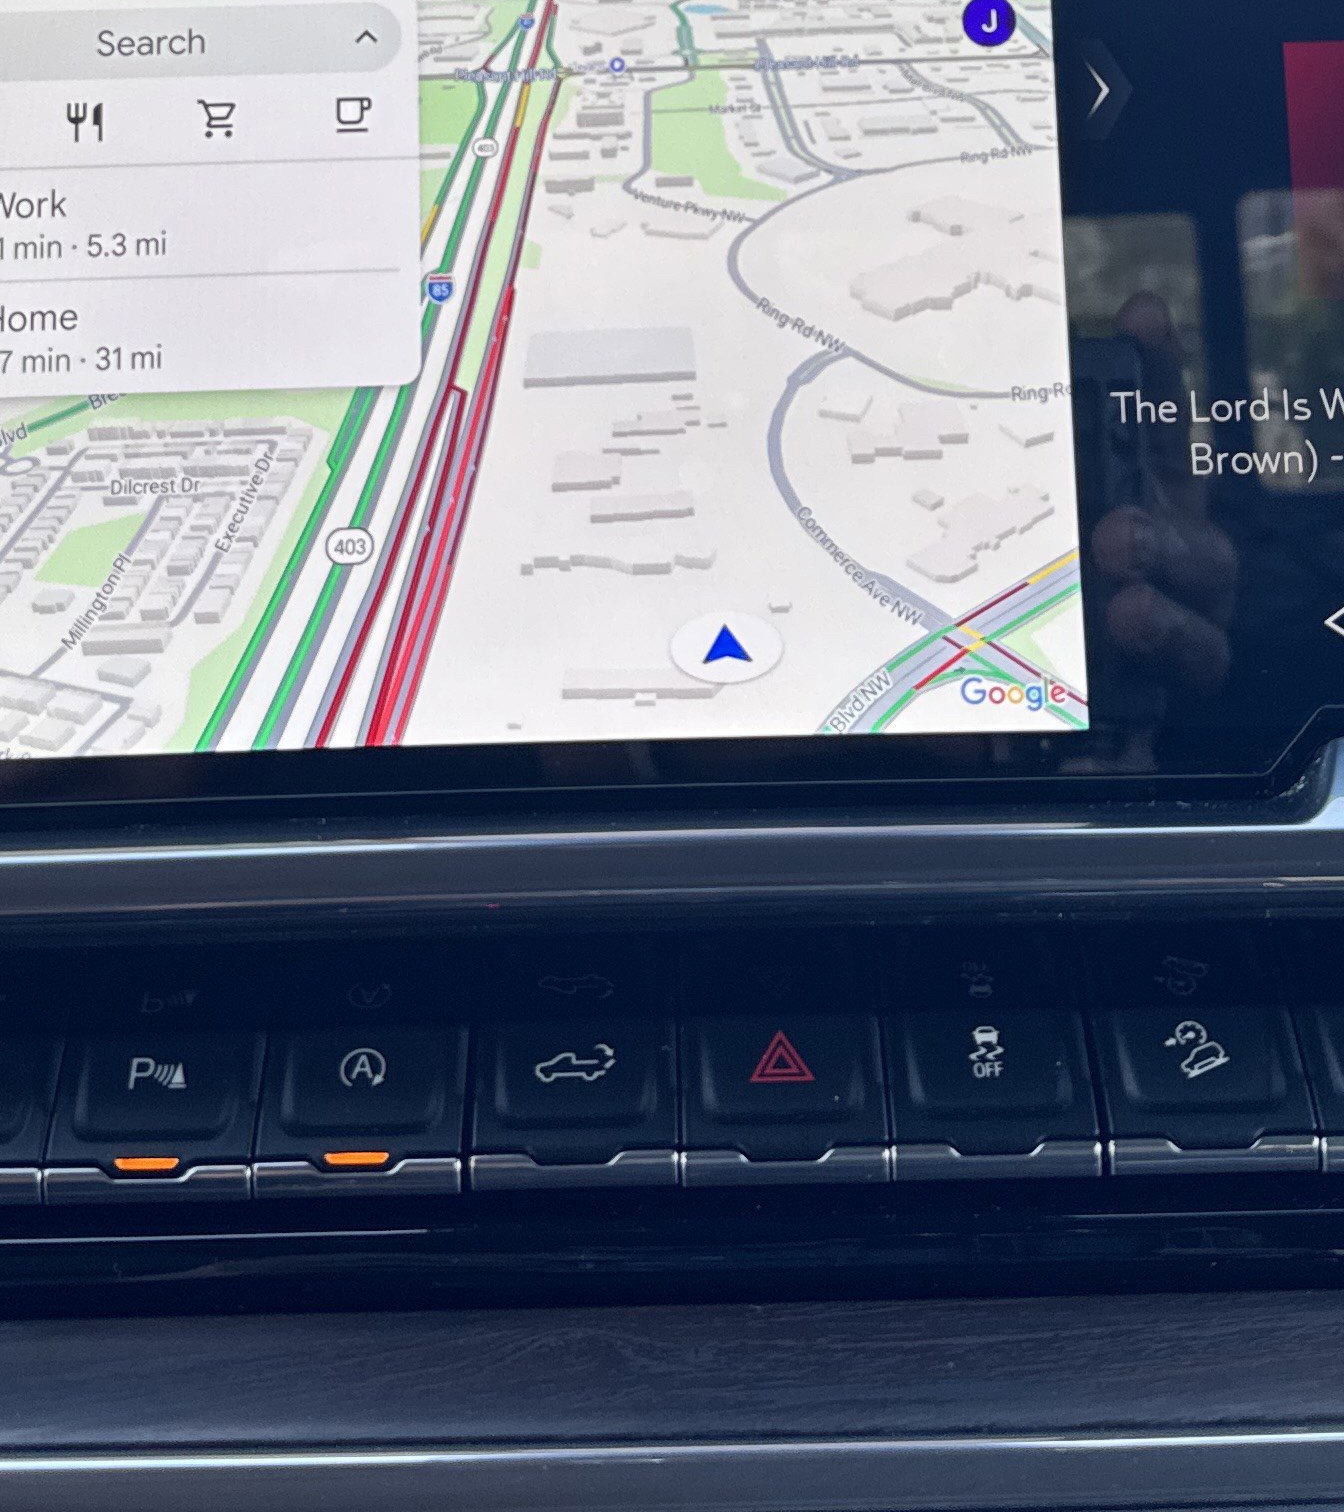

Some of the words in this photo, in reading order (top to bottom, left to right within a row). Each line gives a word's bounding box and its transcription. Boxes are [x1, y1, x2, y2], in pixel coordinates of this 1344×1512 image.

[981, 8, 997, 33] J
[97, 28, 205, 57] Search
[960, 151, 987, 164] Ring
[991, 147, 1009, 160] Rd
[634, 191, 683, 211] Venture
[685, 201, 719, 221] Pkwy
[722, 209, 747, 223] NW
[14, 233, 62, 260] min
[87, 233, 127, 257] 5.3
[136, 229, 166, 256] mi
[757, 297, 791, 329] Ring
[791, 317, 816, 338] Rd
[815, 330, 847, 352] NW
[22, 347, 71, 373] min
[96, 346, 122, 370] 31
[131, 343, 162, 370] mi
[1011, 385, 1049, 403] Ring
[1111, 390, 1178, 424] The
[1190, 386, 1270, 423] Lord
[1283, 388, 1312, 422] Is
[1190, 439, 1318, 482] Brown)
[111, 478, 175, 495] Dilcrest
[181, 477, 200, 493] Dr
[215, 474, 264, 553] Executive
[255, 451, 274, 473] Dr
[334, 538, 366, 555] 403
[797, 507, 863, 583] Commerce
[863, 575, 893, 609] Ave
[893, 600, 923, 626] NW
[61, 573, 121, 650] Millington
[113, 554, 132, 574] Pl
[830, 695, 864, 733] Blvd
[860, 671, 891, 701] NW
[960, 676, 1067, 712] Google
[973, 1061, 1004, 1078] OFF
